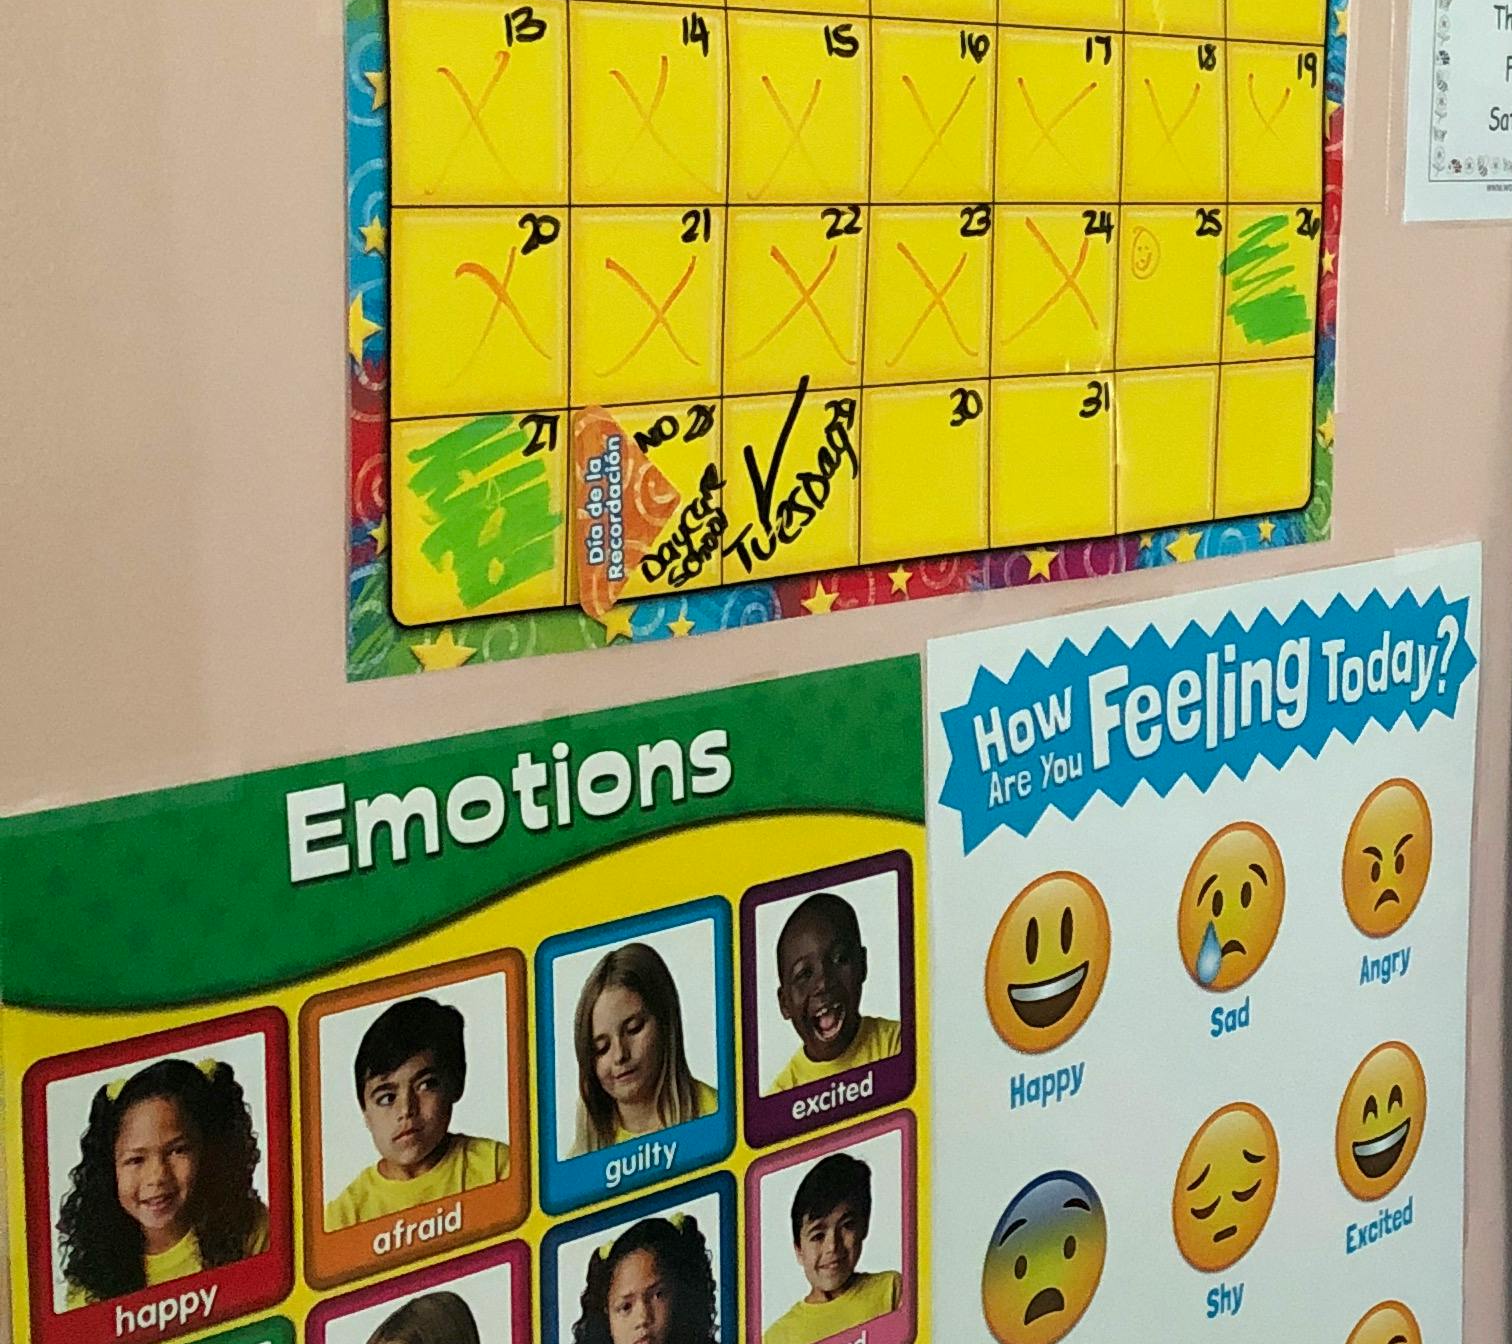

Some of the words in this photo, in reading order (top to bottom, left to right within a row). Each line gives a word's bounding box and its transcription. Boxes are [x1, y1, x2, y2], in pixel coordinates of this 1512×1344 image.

[504, 6, 548, 48] 13
[682, 12, 710, 57] 14
[824, 24, 860, 58] 15
[960, 28, 990, 60] 16
[1084, 34, 1112, 65] 17
[1198, 43, 1217, 71] 18
[1296, 51, 1318, 87] 19
[518, 213, 561, 256] 20
[681, 208, 711, 243] 21
[820, 205, 862, 240] 22
[960, 209, 992, 237] 23
[1083, 210, 1115, 242] 24
[1198, 209, 1224, 238] 25
[1294, 207, 1321, 238] 26
[949, 388, 981, 427] 30
[1079, 381, 1110, 416] 31
[519, 414, 561, 457] 27
[633, 414, 680, 453] NO
[585, 454, 603, 482] la
[585, 484, 605, 519] de
[604, 433, 626, 582] Recordación
[585, 523, 605, 565] Día
[1088, 636, 1311, 771] Feeling
[1321, 614, 1459, 703] Today?
[973, 685, 1074, 773] How
[988, 770, 1033, 809] Are
[1039, 752, 1084, 792] You
[286, 729, 732, 884] Emotions
[1359, 946, 1412, 987] Angry
[1209, 995, 1251, 1038] Sad
[791, 1069, 875, 1122] excited
[1009, 1061, 1085, 1111] Happy
[604, 1135, 678, 1188] guilty
[371, 1201, 464, 1255] afraid
[1345, 1196, 1414, 1256] Excited
[115, 1285, 218, 1338] happy
[1206, 1280, 1245, 1319] Shy
